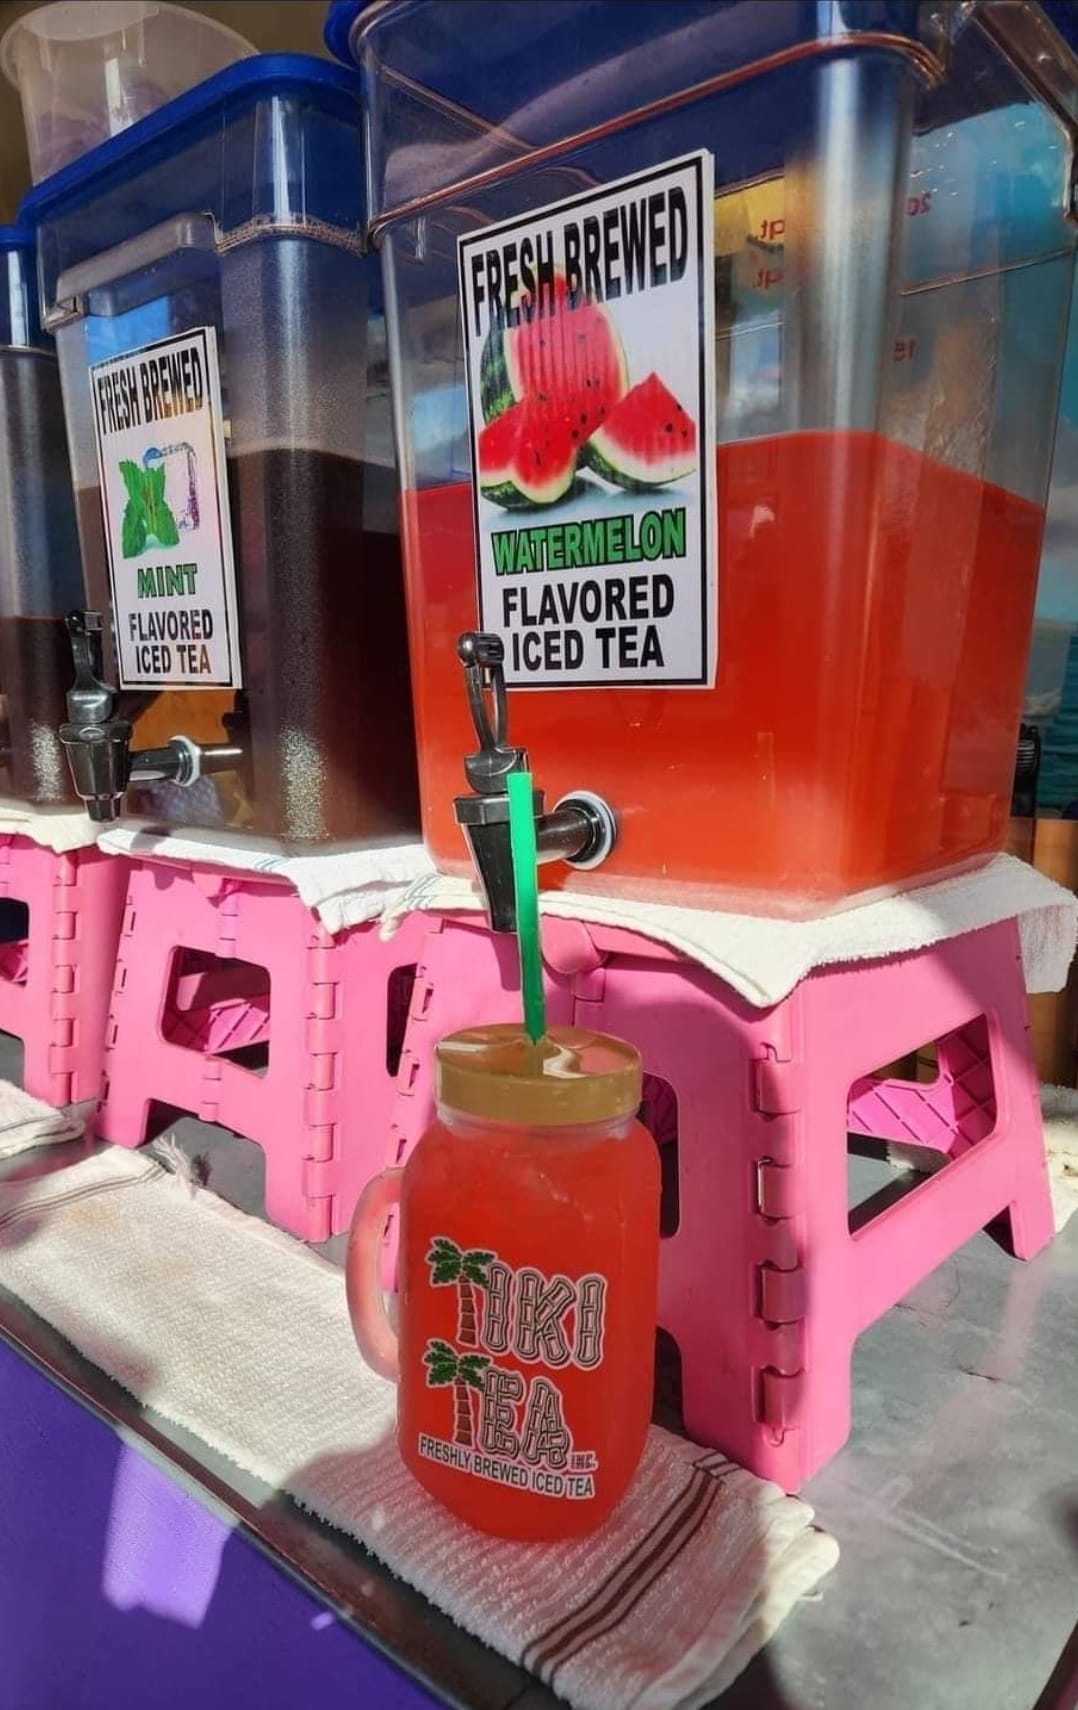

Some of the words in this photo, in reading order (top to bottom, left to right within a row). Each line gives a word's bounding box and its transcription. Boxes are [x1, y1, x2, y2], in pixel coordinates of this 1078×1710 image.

[471, 230, 556, 337] FRESH
[563, 186, 688, 312] BREWED
[97, 367, 142, 435] FRESH
[140, 346, 203, 424] BREWED
[491, 507, 687, 576] WATERMELON
[137, 563, 198, 599] MINT
[502, 573, 675, 628] FLAVORED
[128, 609, 213, 641] FLAVORED
[511, 629, 584, 671] ICED
[595, 625, 665, 669] TEA
[135, 645, 171, 673] ICED
[176, 644, 211, 674] TEA
[419, 1435, 471, 1469] FRESHLY
[473, 1455, 529, 1489] BREWED
[531, 1469, 564, 1495] ICED
[567, 1477, 593, 1497] TEA
